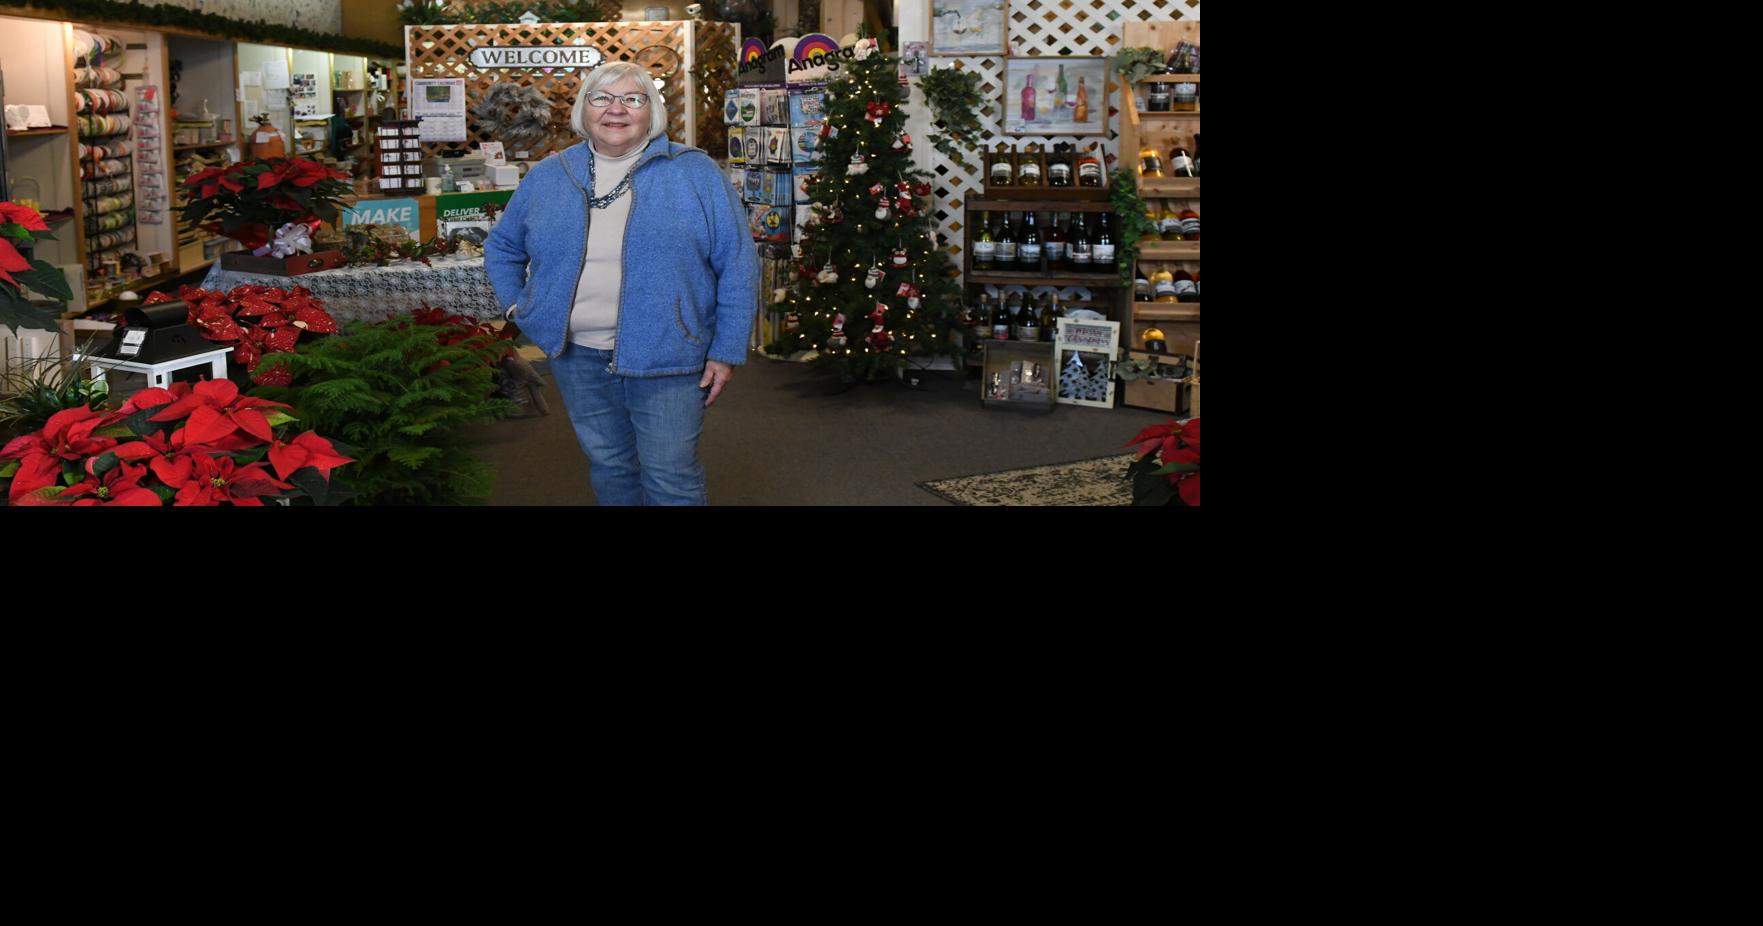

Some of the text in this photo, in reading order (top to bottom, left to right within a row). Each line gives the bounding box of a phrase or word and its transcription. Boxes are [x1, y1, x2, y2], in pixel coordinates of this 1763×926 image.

[481, 49, 590, 65] WELCOME
[738, 44, 785, 75] Anagram
[788, 45, 857, 74] Anagra
[351, 206, 412, 225] MAKE
[443, 207, 481, 217] DELIVER
